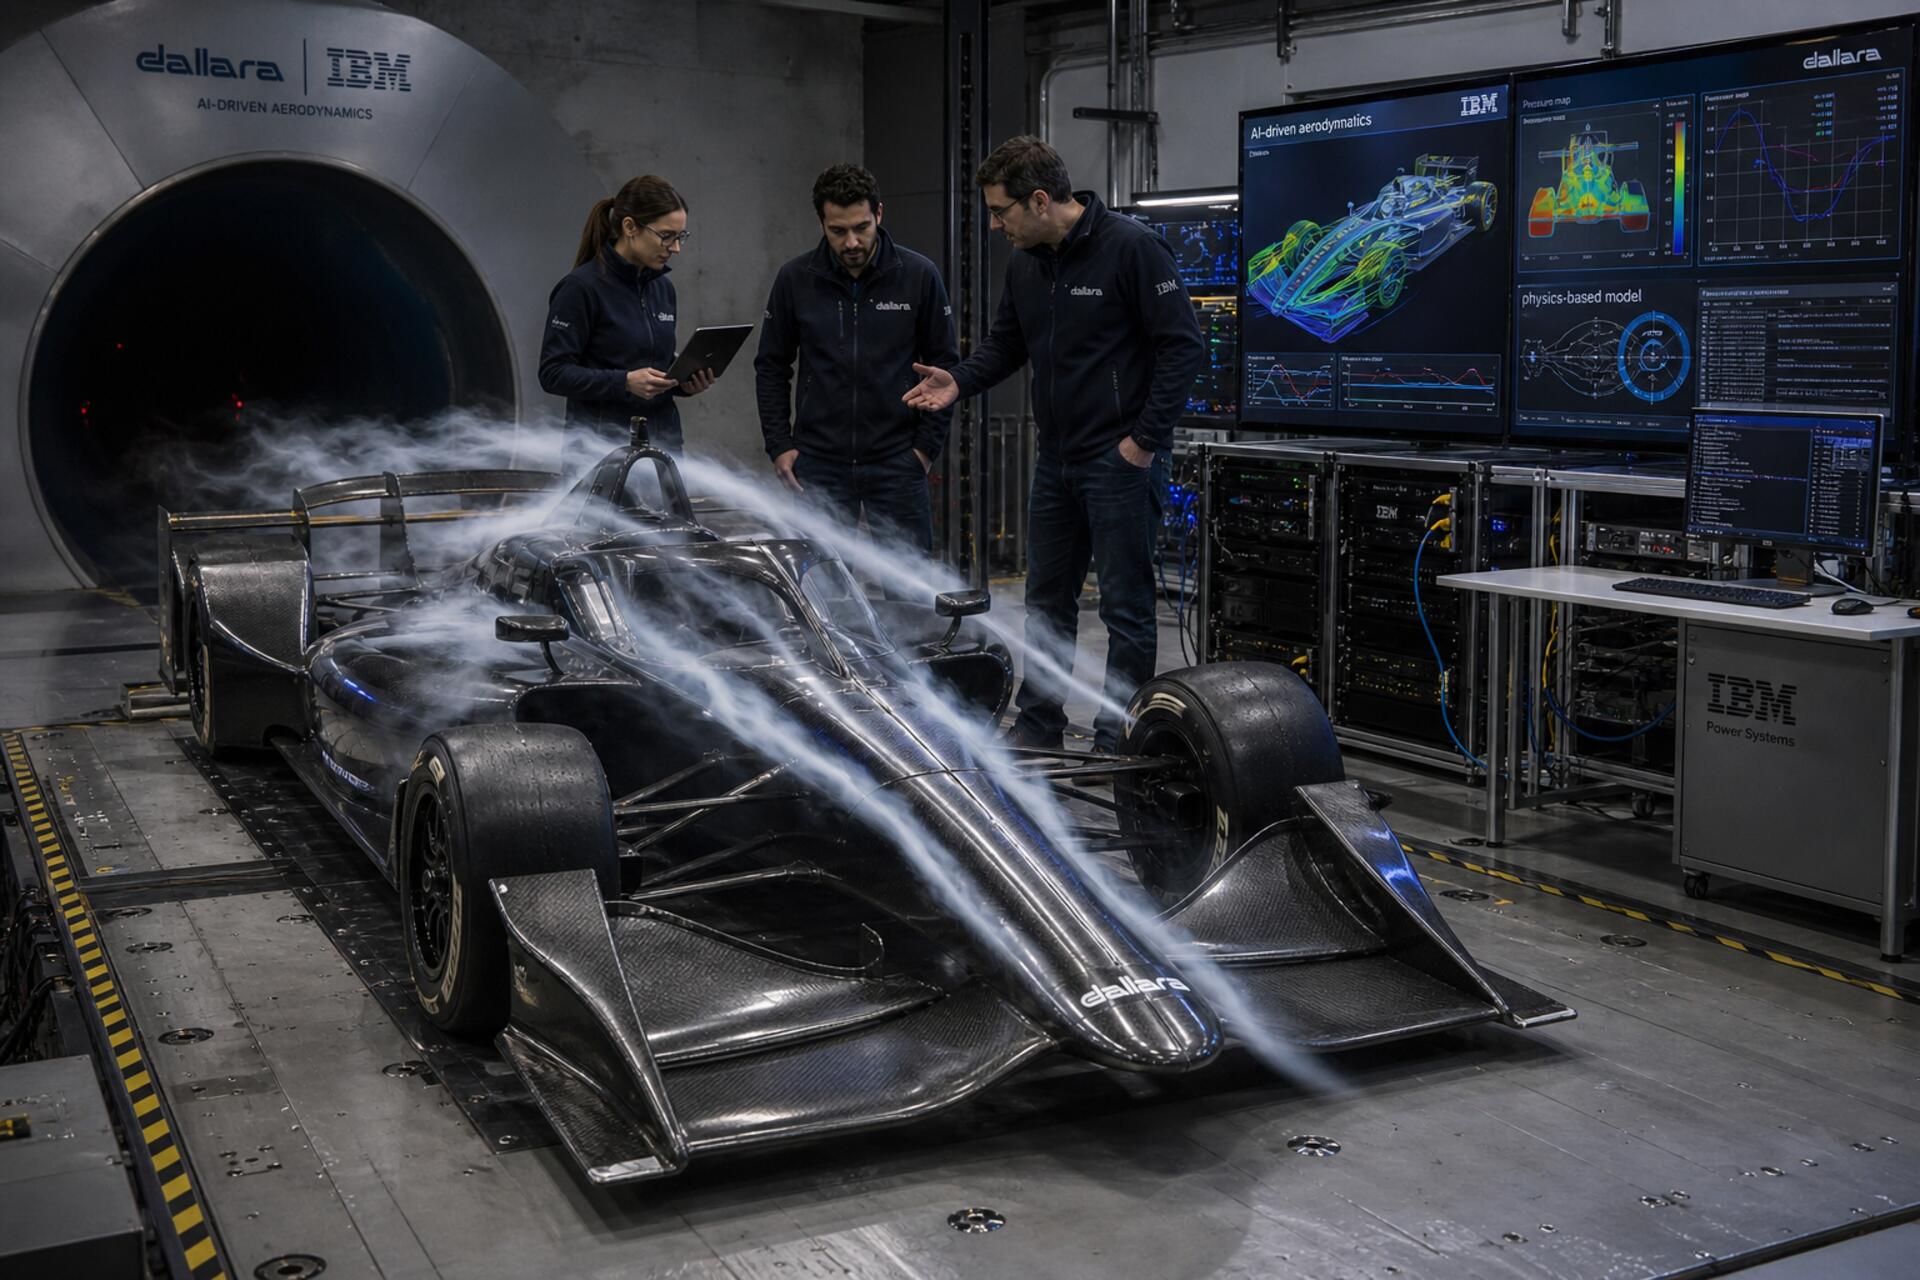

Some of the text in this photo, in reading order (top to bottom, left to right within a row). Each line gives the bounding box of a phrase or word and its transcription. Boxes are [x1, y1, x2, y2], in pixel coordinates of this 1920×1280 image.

[136, 44, 411, 92] dallara IBM
[1803, 48, 1881, 69] dallara
[197, 98, 373, 120] AI-DRIVEN AERODYNAMICS
[1461, 93, 1498, 116] IBM
[1251, 123, 1296, 140] AI-driven
[1156, 279, 1179, 295] IBM
[1605, 289, 1642, 303] model
[1707, 672, 1797, 726] IBM
[1706, 720, 1796, 747] Power Systems
[1080, 975, 1190, 1008] dallara
